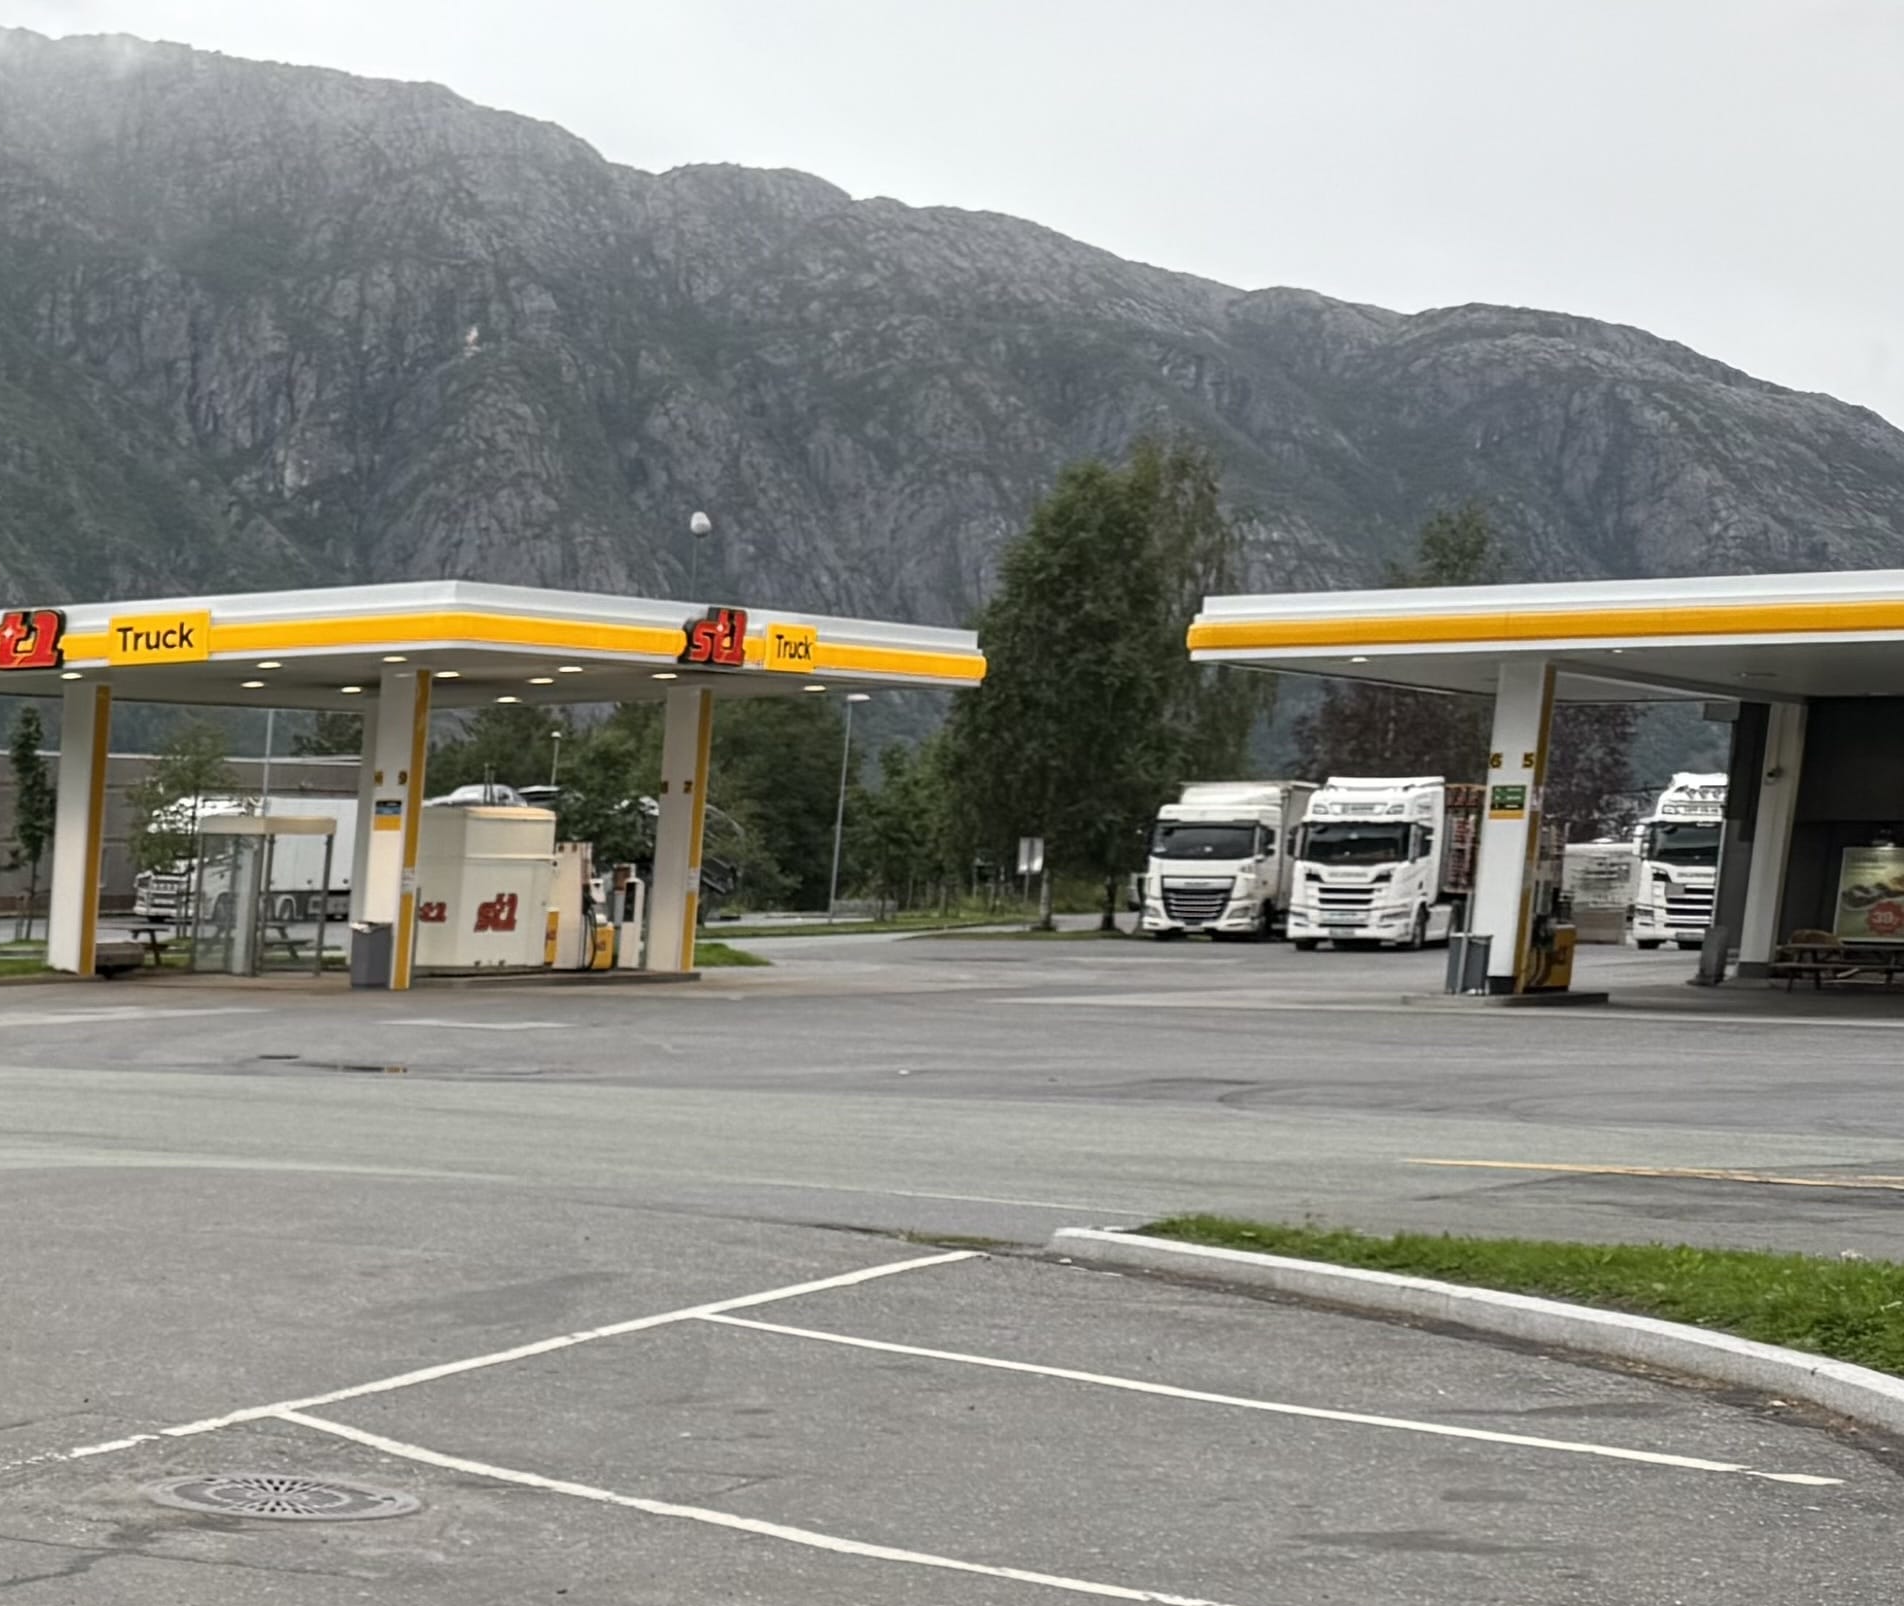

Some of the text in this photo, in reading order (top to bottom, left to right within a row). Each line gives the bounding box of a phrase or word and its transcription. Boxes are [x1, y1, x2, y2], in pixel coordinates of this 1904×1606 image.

[116, 622, 195, 652] Truck
[680, 607, 812, 667] st1 Truck
